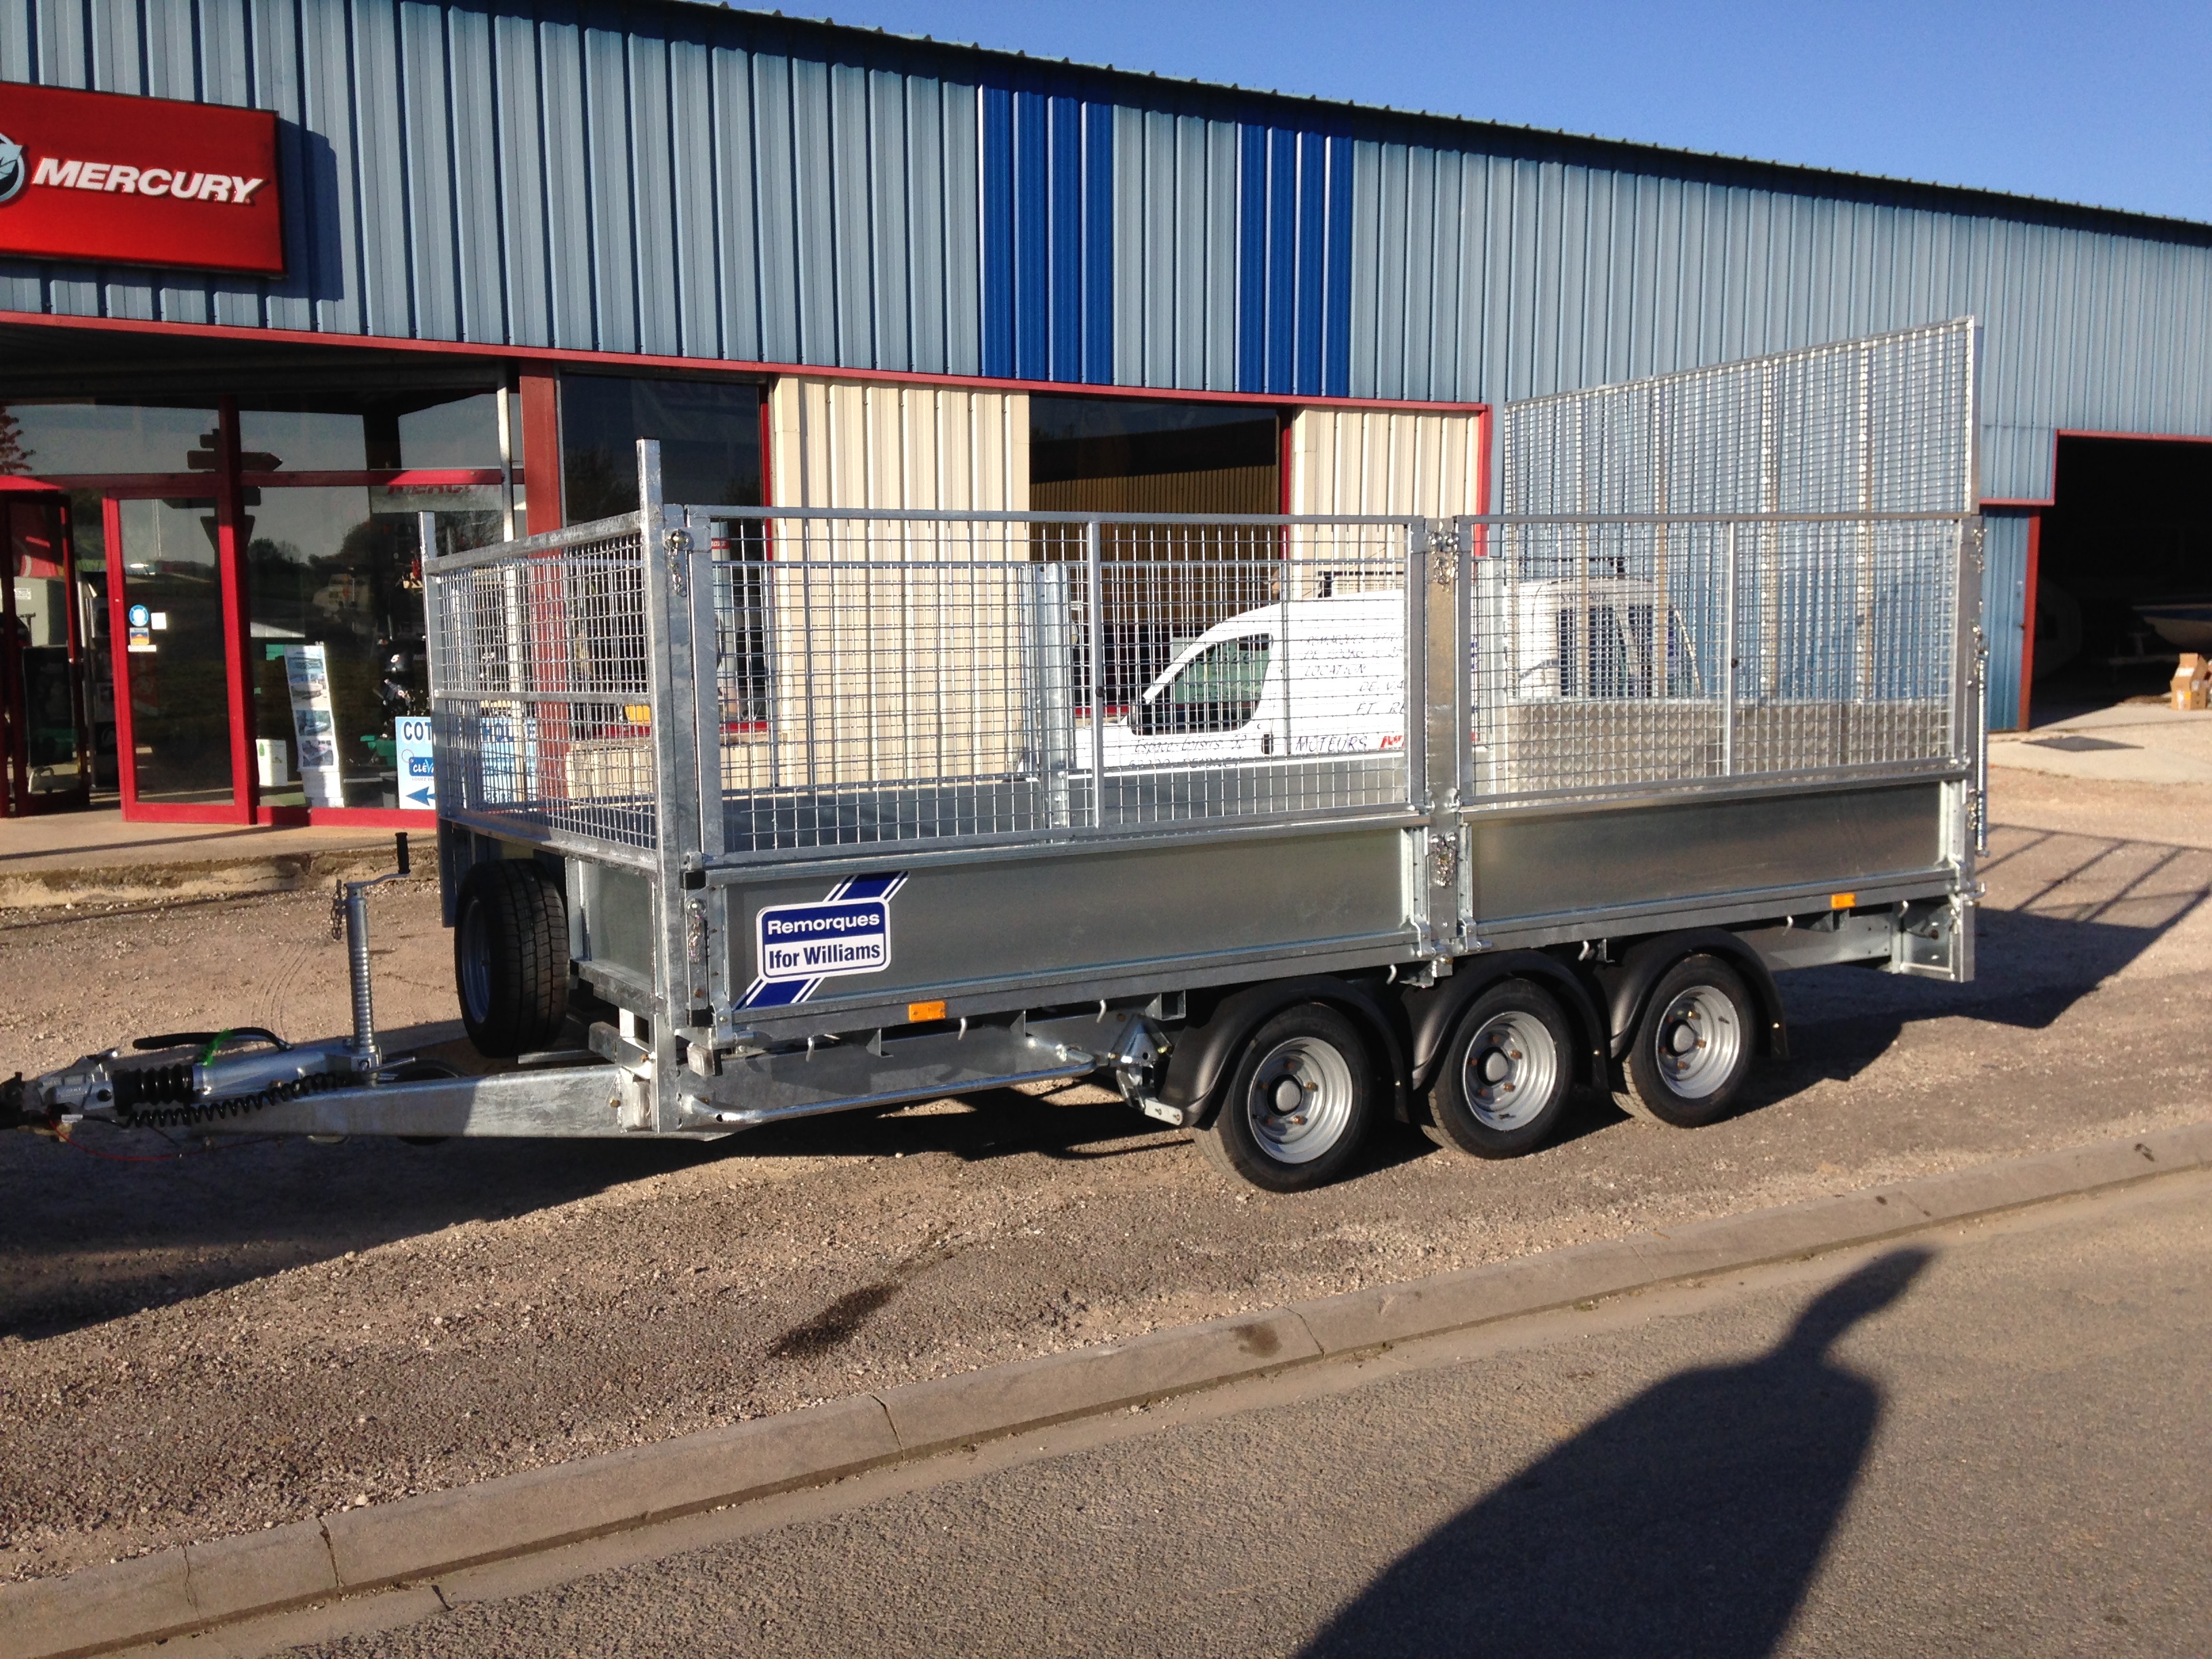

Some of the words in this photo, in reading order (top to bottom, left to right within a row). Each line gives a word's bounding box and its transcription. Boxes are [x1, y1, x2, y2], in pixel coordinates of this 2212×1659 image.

[34, 157, 264, 204] MERCURY
[1296, 735, 1368, 752] MOTEURS
[767, 913, 880, 935] Remorques
[769, 949, 800, 969] Ifor
[804, 943, 881, 965] Williams
